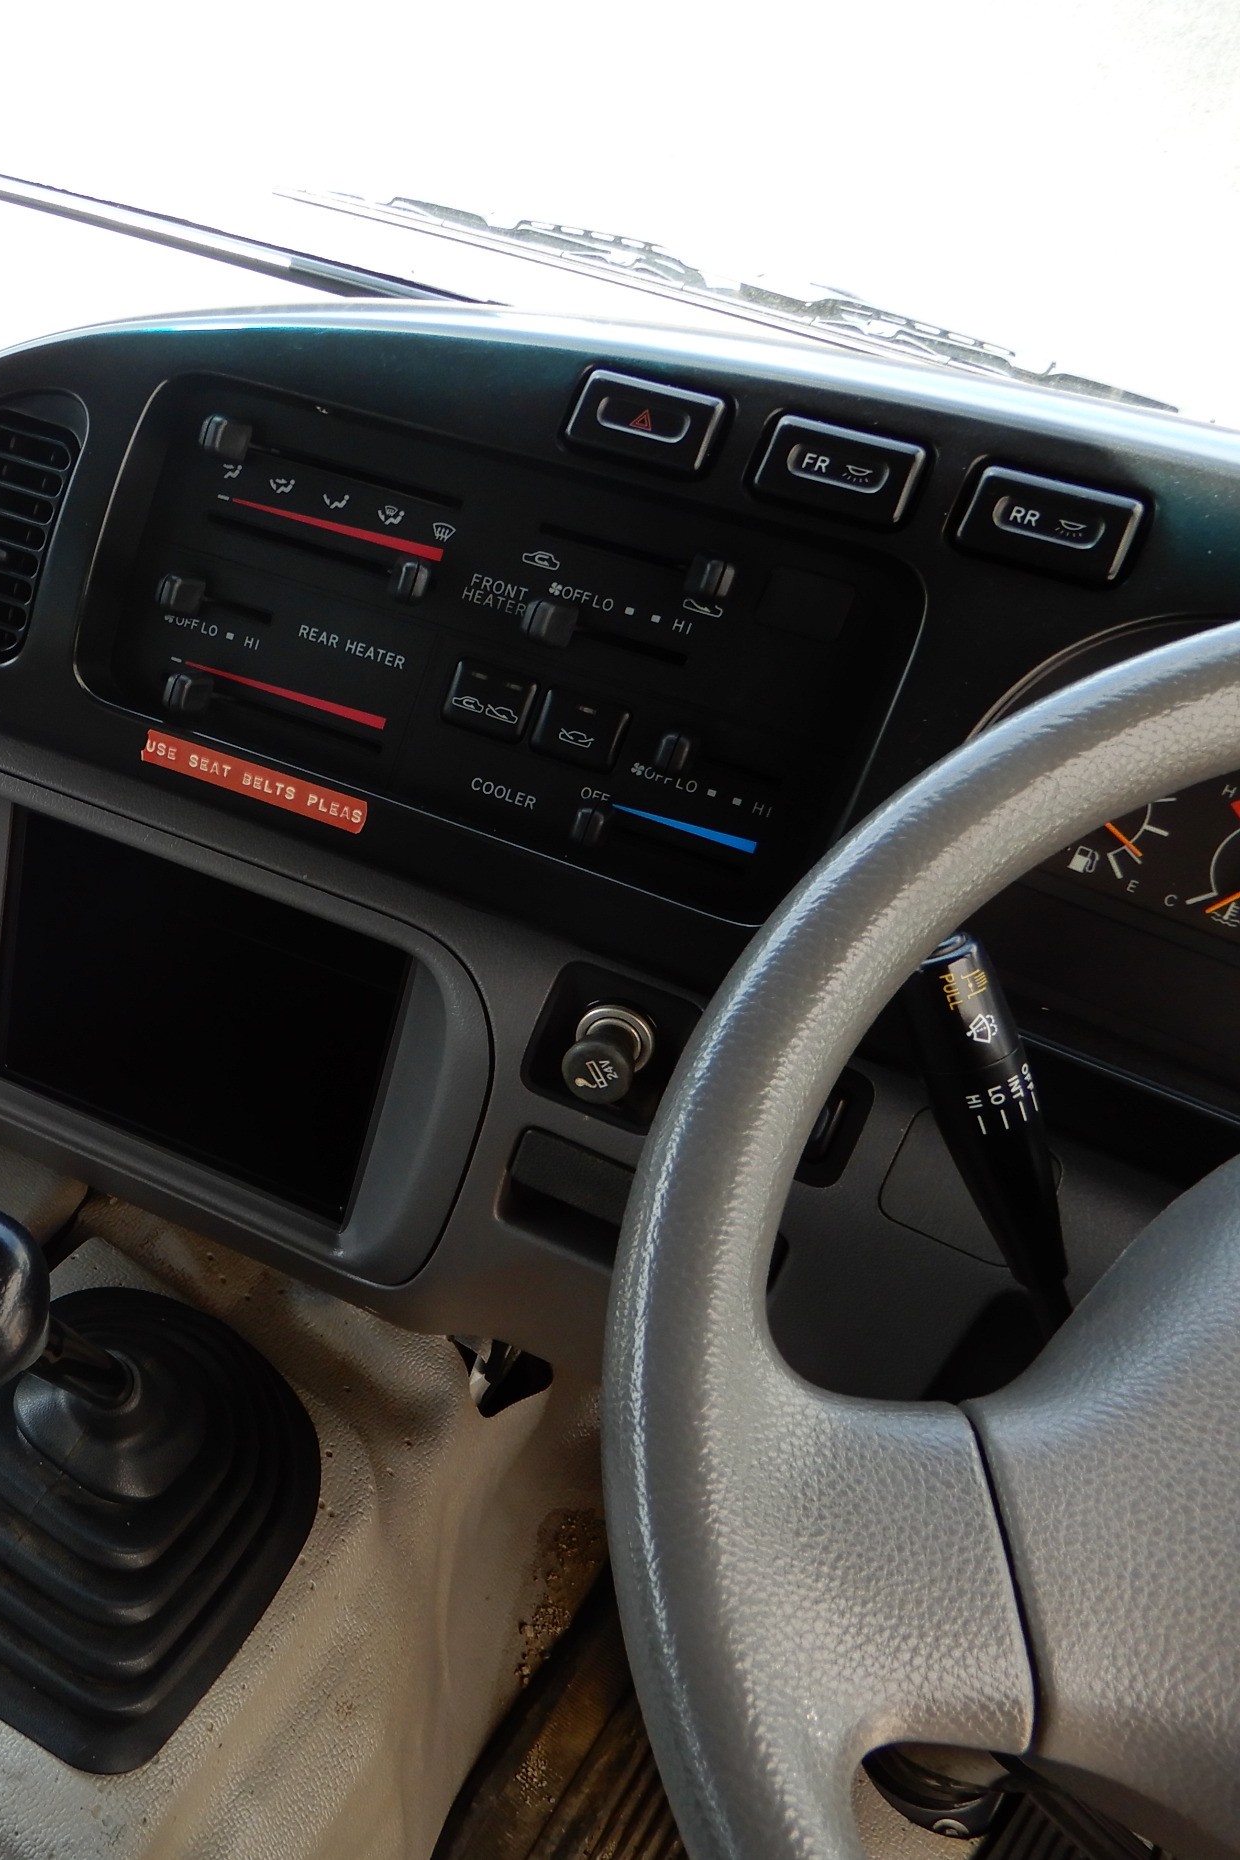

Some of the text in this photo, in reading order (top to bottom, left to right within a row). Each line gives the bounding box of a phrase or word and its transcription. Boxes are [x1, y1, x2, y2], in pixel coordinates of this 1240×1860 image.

[801, 452, 830, 473] FR
[1009, 505, 1041, 528] RR
[470, 573, 529, 601] FRONT
[461, 587, 527, 617] HEATER
[561, 586, 693, 635] OFF LO HI
[243, 635, 260, 651] HI
[297, 623, 406, 670] REAR HEATER
[145, 739, 363, 824] USE SEAT BELTS PLEAS
[1221, 784, 1237, 798] H
[470, 776, 537, 810] COOLER
[751, 801, 772, 818] HI
[1126, 879, 1140, 893] E
[1164, 894, 1178, 907] C
[938, 972, 964, 1012] PULL
[598, 1060, 619, 1080] 24V
[987, 1085, 1006, 1105] LO
[1006, 1074, 1025, 1099] INT
[965, 1094, 983, 1109] HI
